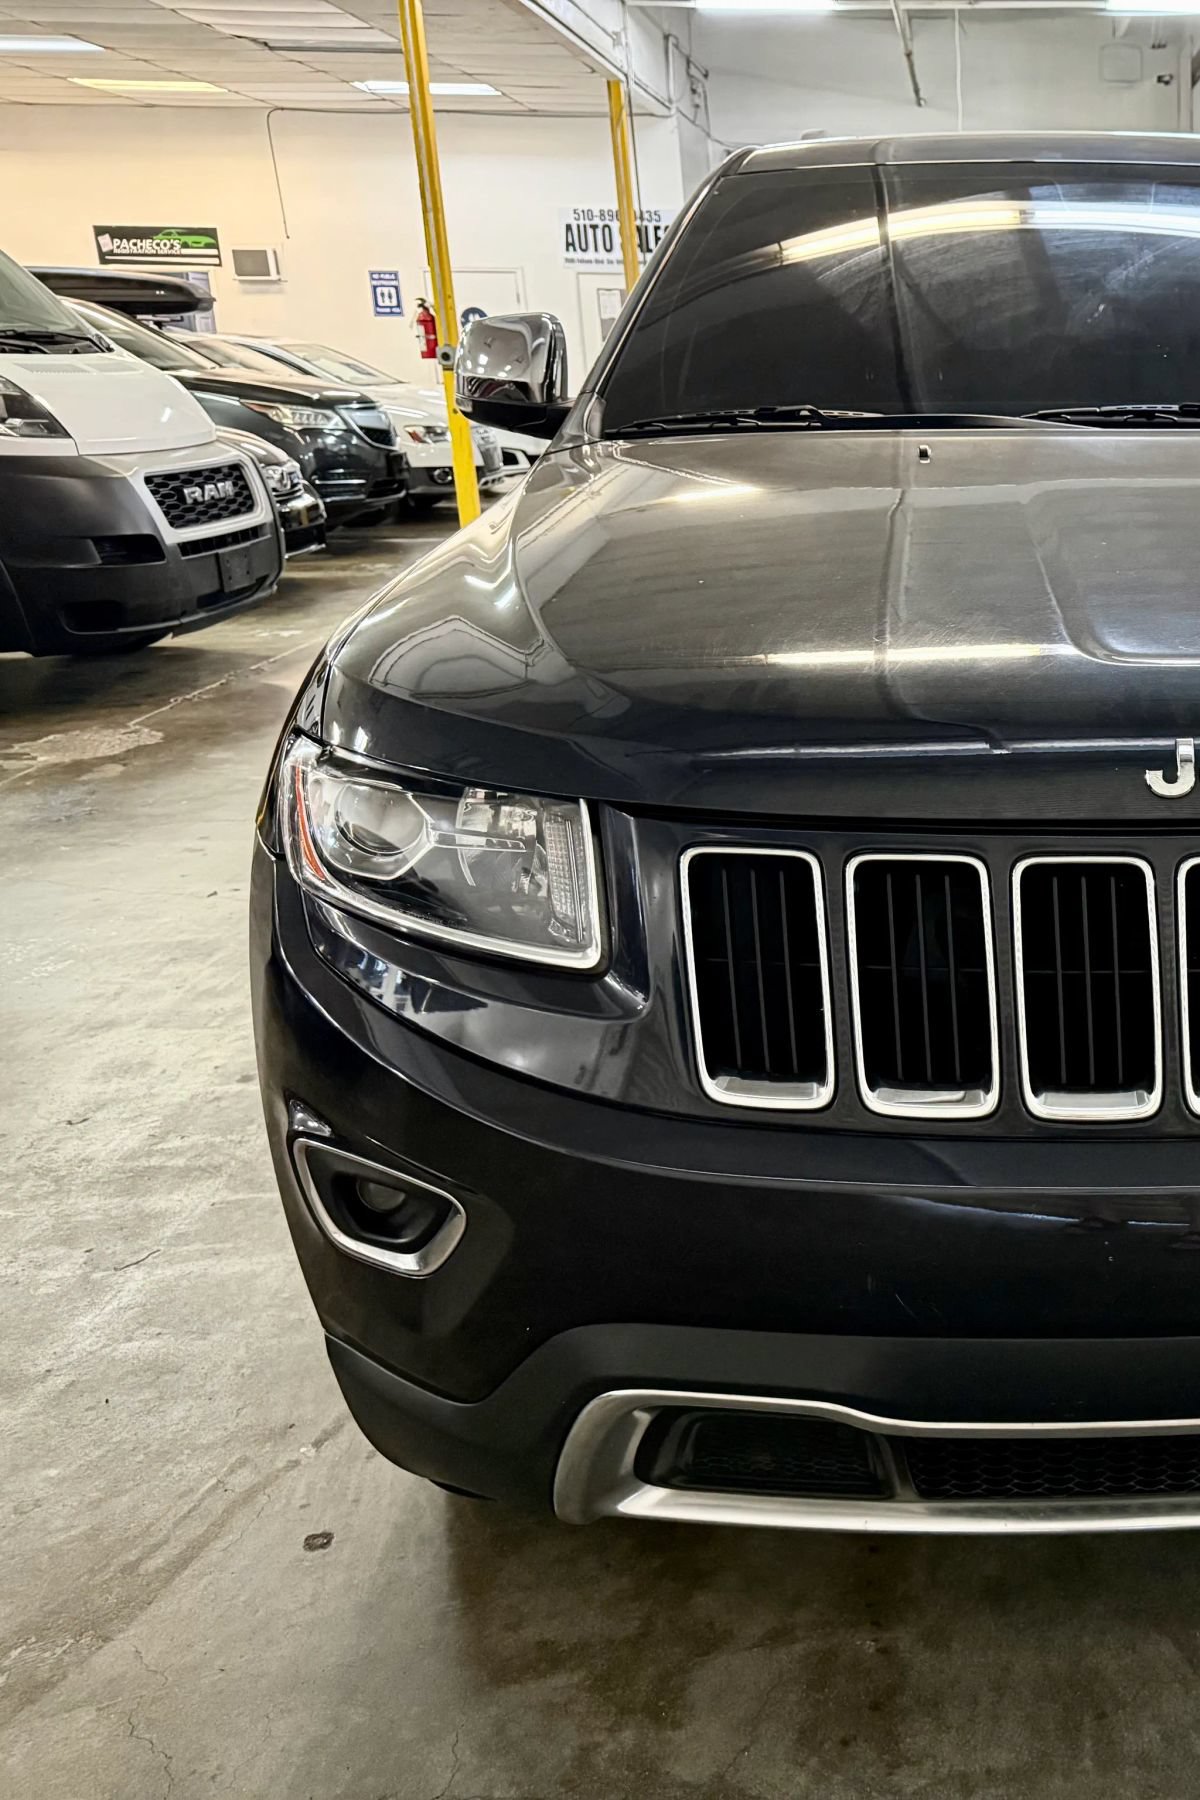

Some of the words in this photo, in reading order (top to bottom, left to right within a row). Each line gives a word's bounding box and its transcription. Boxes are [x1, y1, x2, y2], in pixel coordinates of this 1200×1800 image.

[113, 238, 181, 250] PACHECO'S
[565, 223, 613, 252] AUTO
[183, 481, 234, 504] RAM
